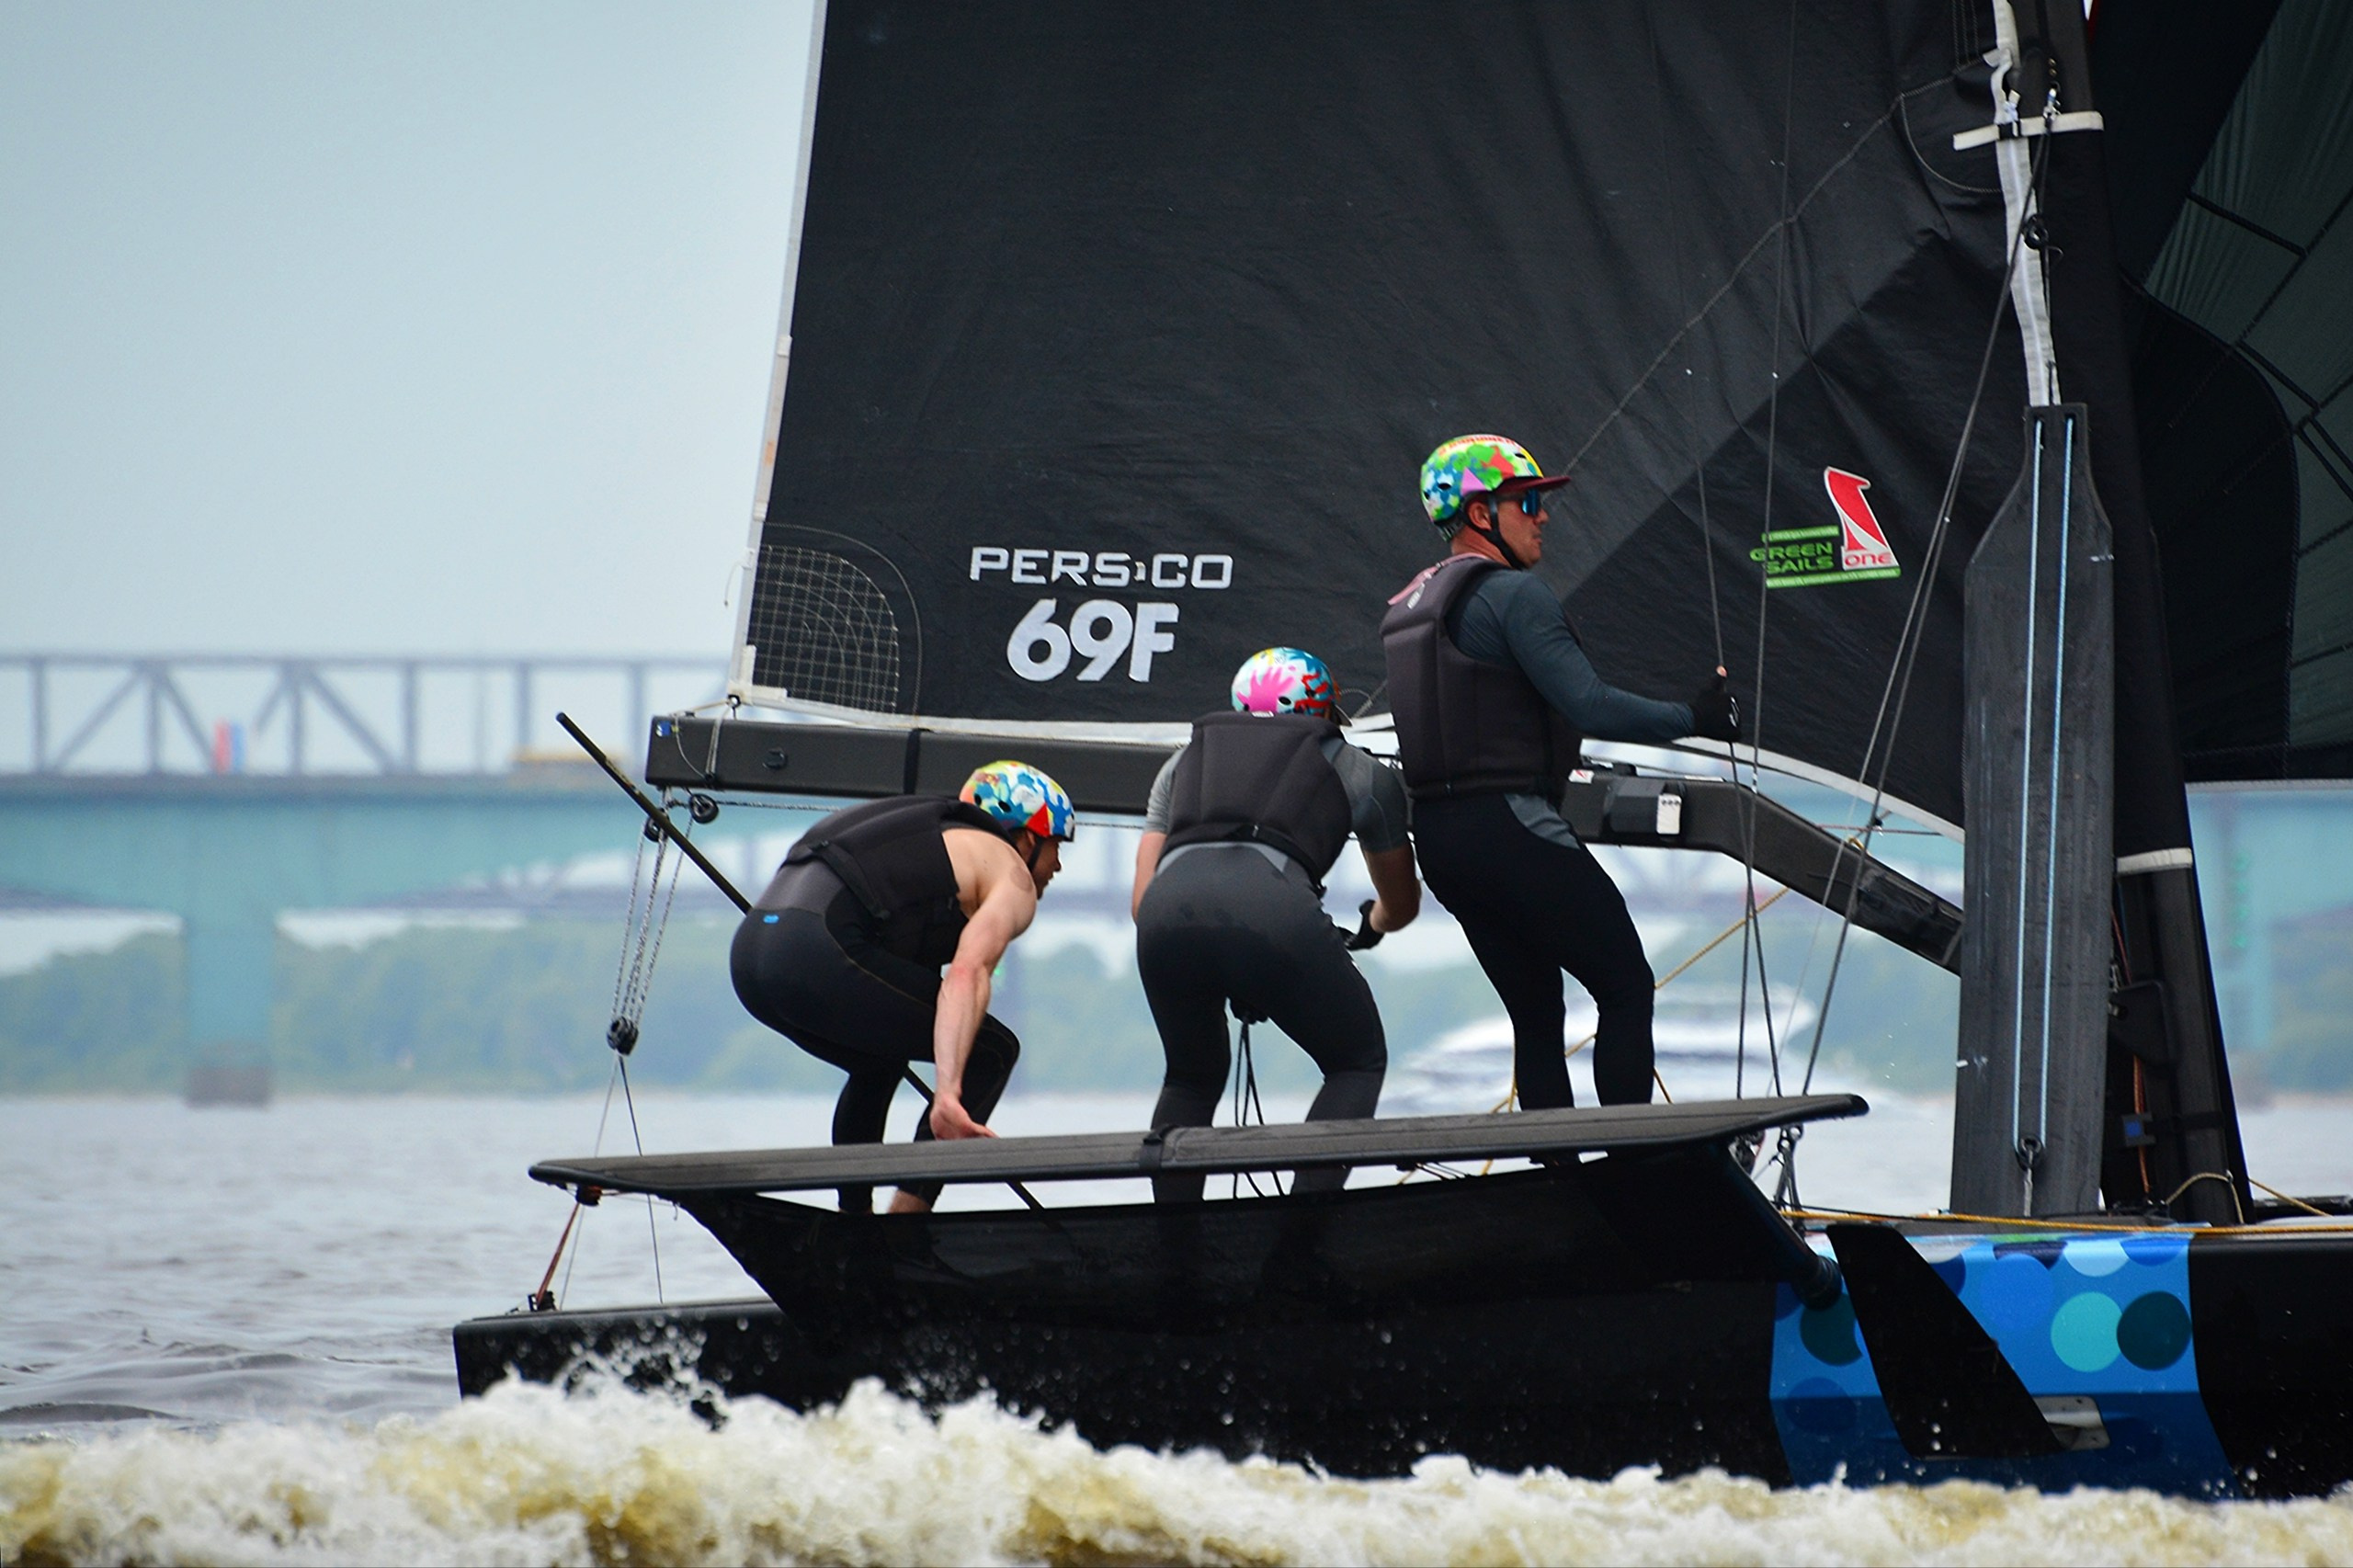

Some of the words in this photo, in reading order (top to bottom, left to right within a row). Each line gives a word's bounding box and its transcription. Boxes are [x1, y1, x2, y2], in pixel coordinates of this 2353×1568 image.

[1749, 541, 1834, 562] GREEN
[1766, 555, 1835, 574] SAILS
[1006, 598, 1180, 682] 69F
